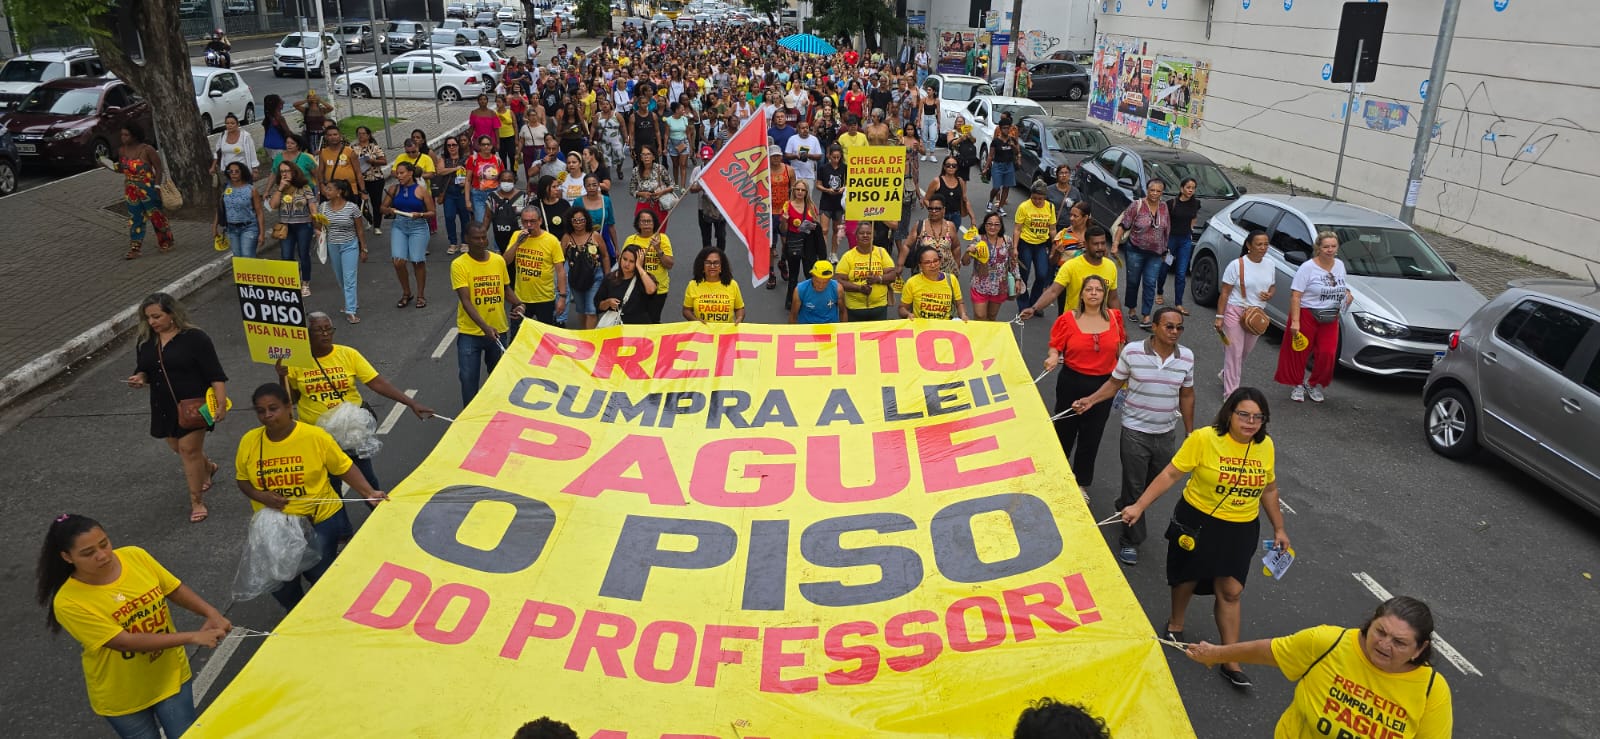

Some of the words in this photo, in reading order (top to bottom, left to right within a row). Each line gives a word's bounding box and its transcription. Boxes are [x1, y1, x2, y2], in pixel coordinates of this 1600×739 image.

[850, 156, 885, 165] CHEGA
[889, 156, 902, 164] DE
[849, 178, 889, 187] PAGUE
[893, 177, 902, 187] O
[849, 191, 880, 202] PISO
[884, 188, 900, 201] JÁ
[517, 258, 542, 269] PAGUE
[236, 273, 275, 284] PREFEITO
[278, 277, 299, 287] QUE,
[240, 285, 264, 300] NÃO
[267, 289, 299, 304] PAGA
[243, 302, 256, 319] O
[260, 304, 302, 325] PISO
[920, 303, 950, 312] PAGUE
[247, 323, 270, 335] PISA
[273, 327, 288, 338] NA
[291, 329, 306, 340] LEI
[529, 330, 995, 380] PREFEITO,
[508, 377, 799, 429] CUMPRA
[816, 390, 863, 426] A
[881, 374, 1010, 422] LEI!
[460, 407, 1036, 507] PAGUE
[1218, 472, 1265, 486] PAGUE
[1216, 486, 1225, 495] O
[412, 484, 556, 574] O
[599, 493, 1064, 612] PISO
[343, 562, 490, 645] DO
[500, 573, 1103, 694] PROFESSOR!
[1329, 686, 1373, 719] CUMPRA
[1376, 712, 1384, 724] A
[1317, 717, 1332, 736] O
[1323, 697, 1403, 739] PAGUE
